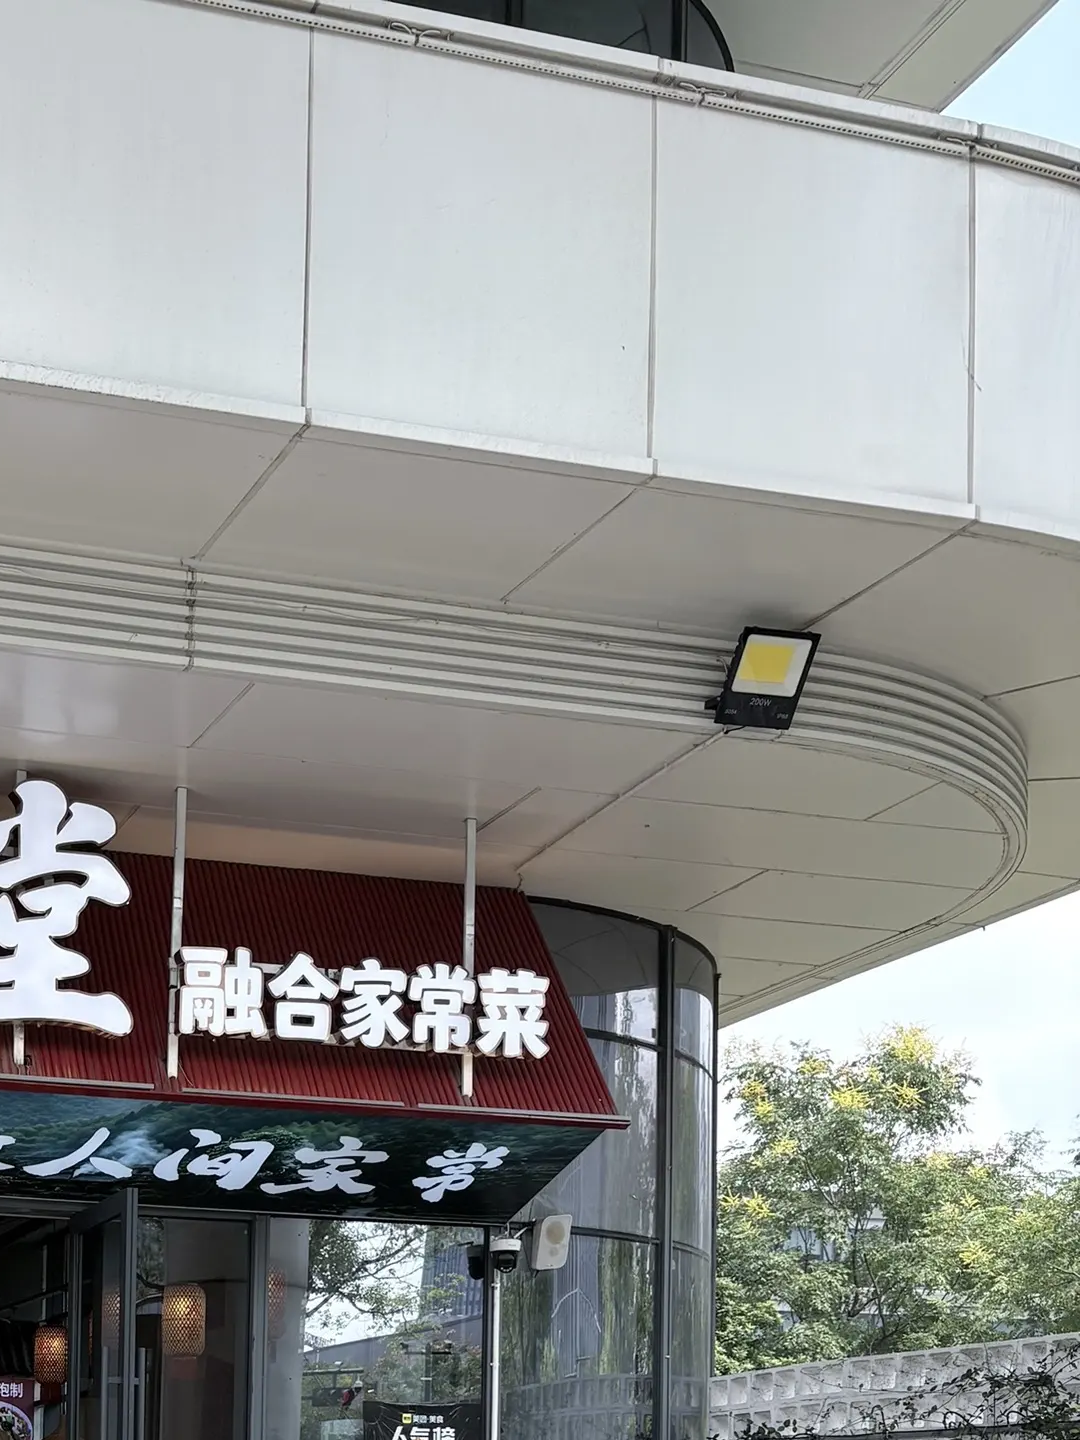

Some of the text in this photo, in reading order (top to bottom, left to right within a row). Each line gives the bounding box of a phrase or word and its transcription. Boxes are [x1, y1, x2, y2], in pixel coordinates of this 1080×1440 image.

[176, 945, 552, 1060] 融合家常菜
